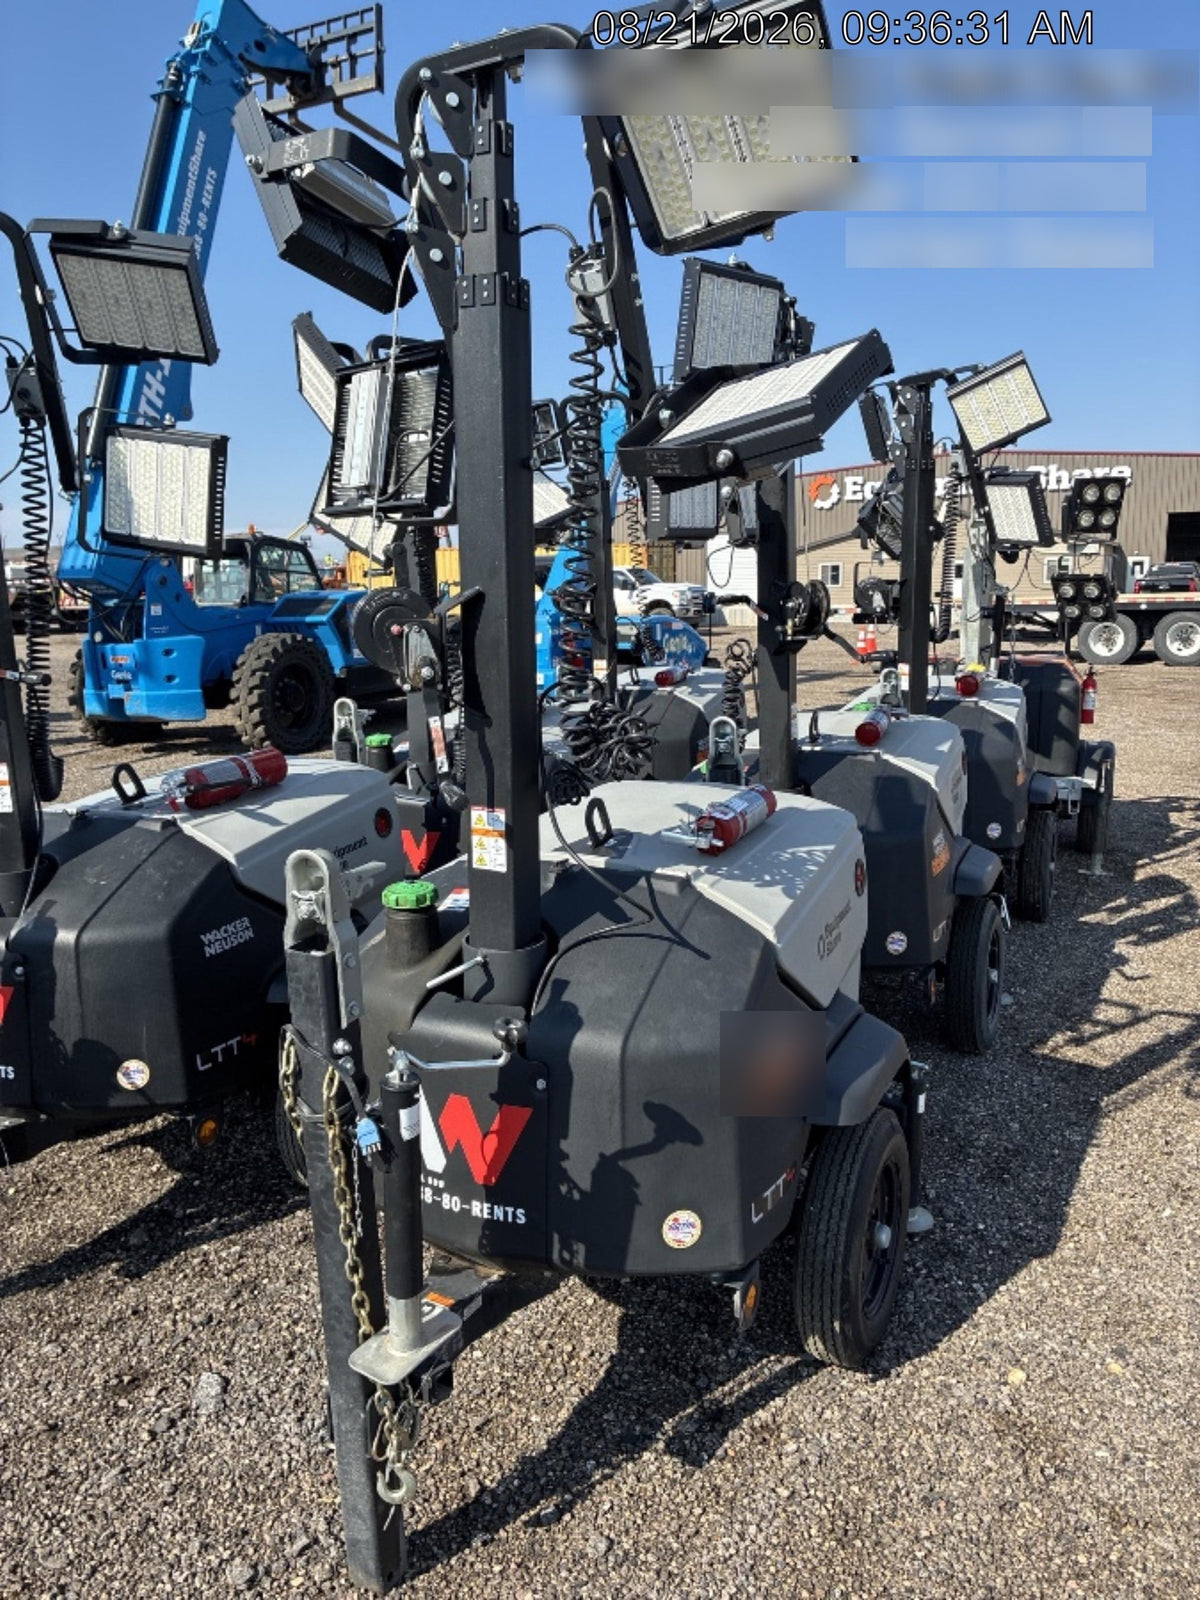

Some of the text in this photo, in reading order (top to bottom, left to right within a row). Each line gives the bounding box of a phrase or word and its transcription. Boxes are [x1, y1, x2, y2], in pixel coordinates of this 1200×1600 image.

[177, 129, 206, 236] uipmentShare
[200, 917, 251, 944] WACKER
[204, 928, 254, 957] NEUSON
[420, 1187, 527, 1225] 8-80-RENTS
